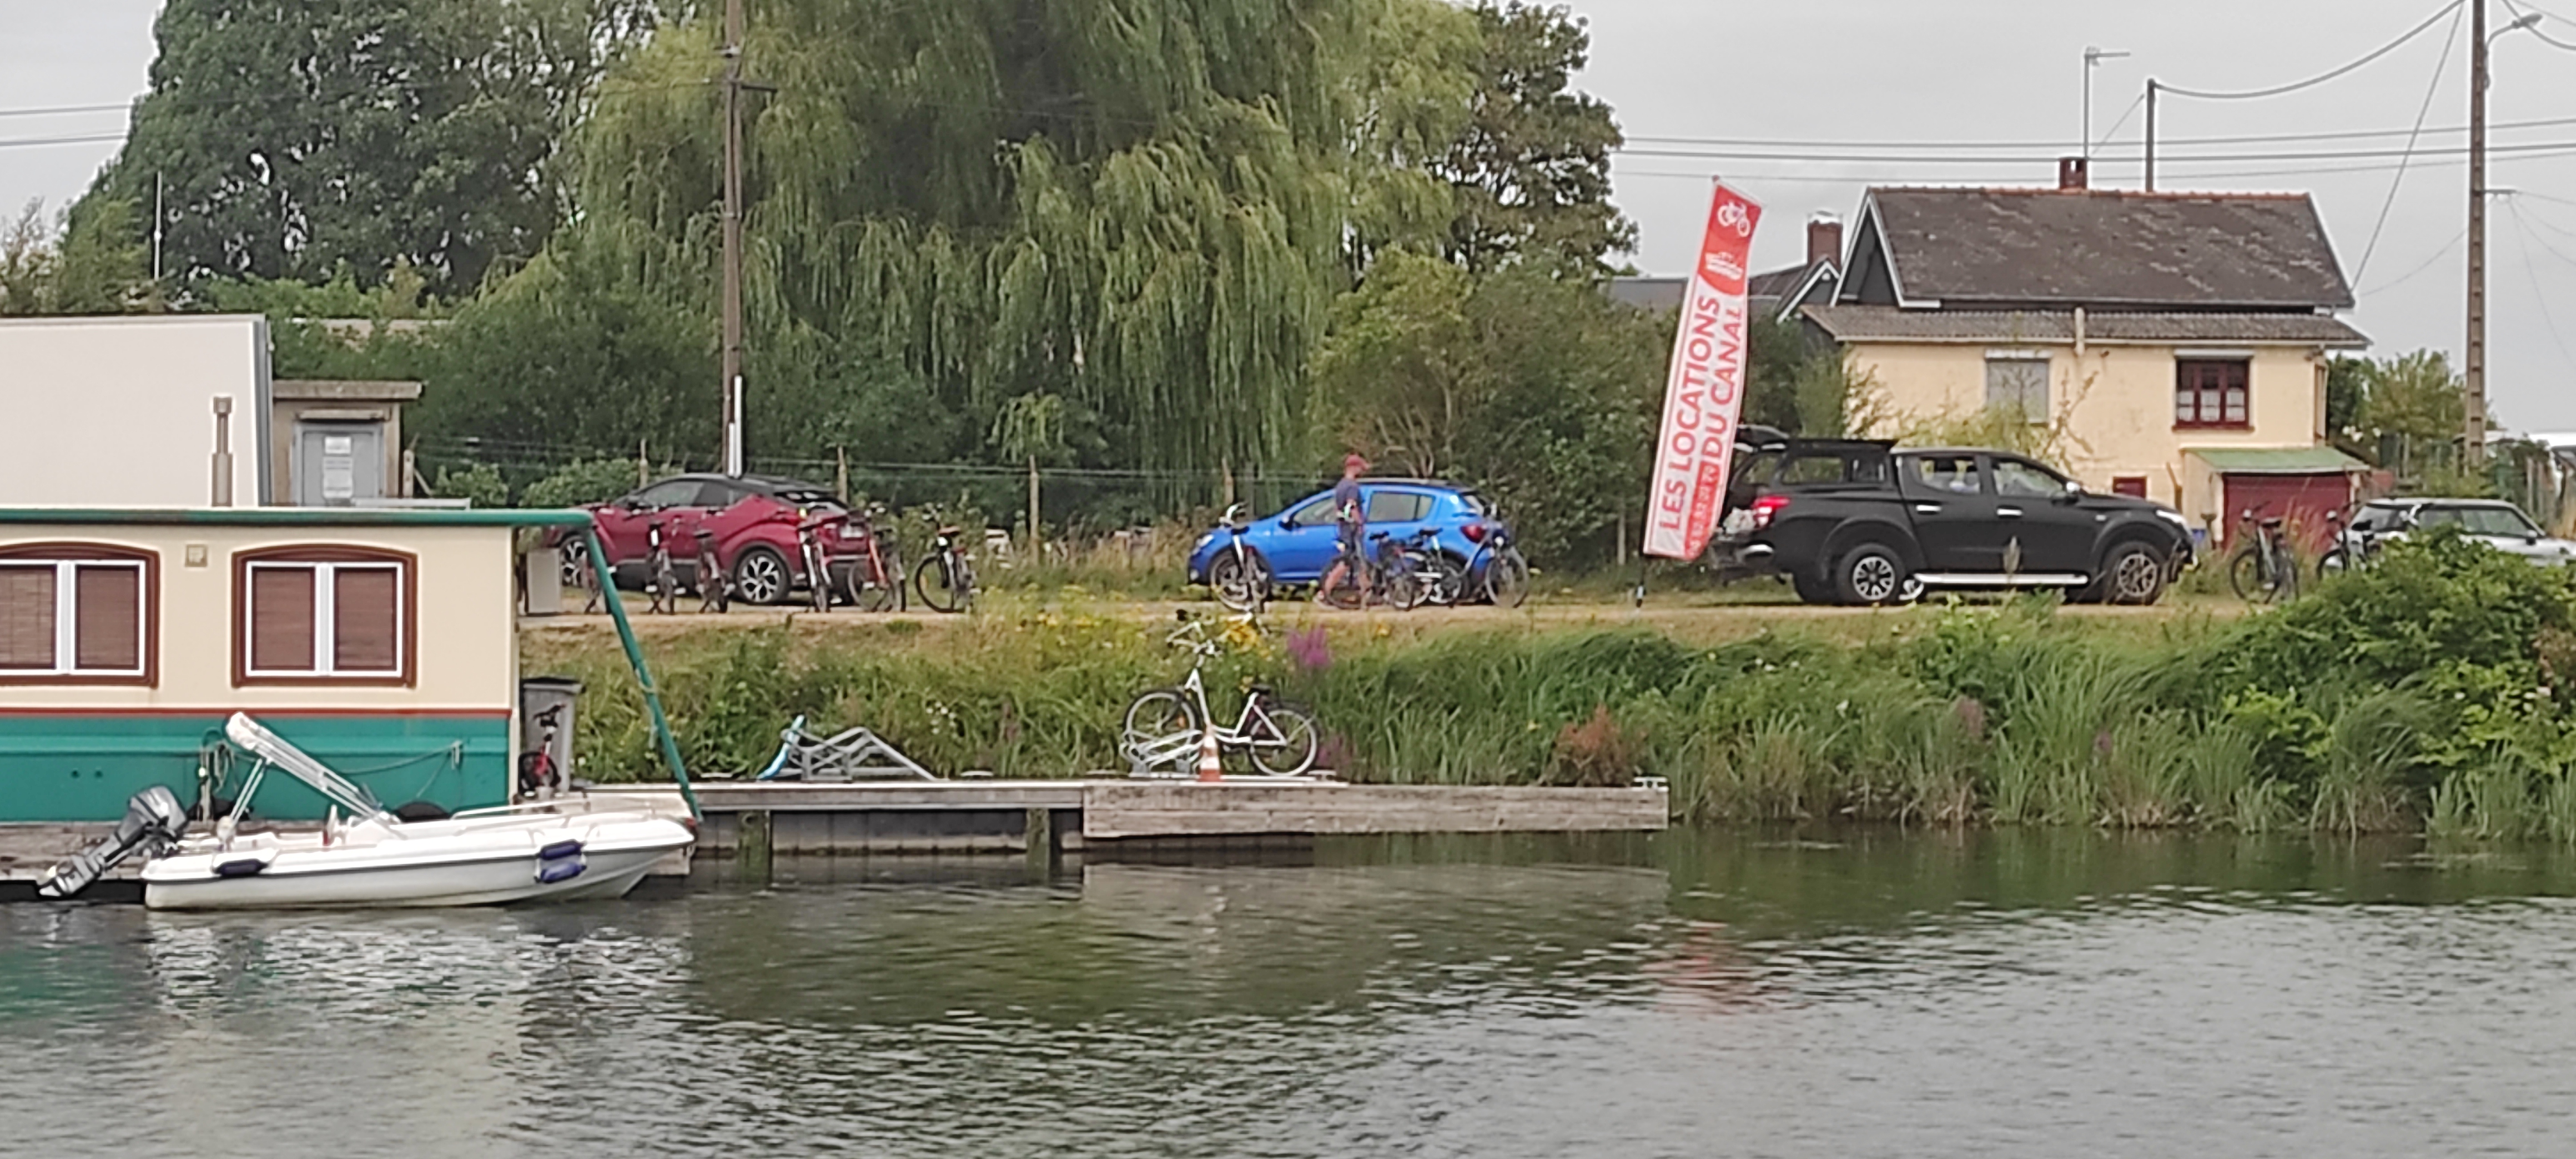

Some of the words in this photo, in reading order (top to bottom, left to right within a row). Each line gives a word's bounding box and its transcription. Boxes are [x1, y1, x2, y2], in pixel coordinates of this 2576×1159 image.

[1669, 296, 1719, 471] LOCATIONS
[1710, 309, 1742, 405] CANAL
[1702, 413, 1727, 457] DU
[1659, 480, 1687, 530] LES
